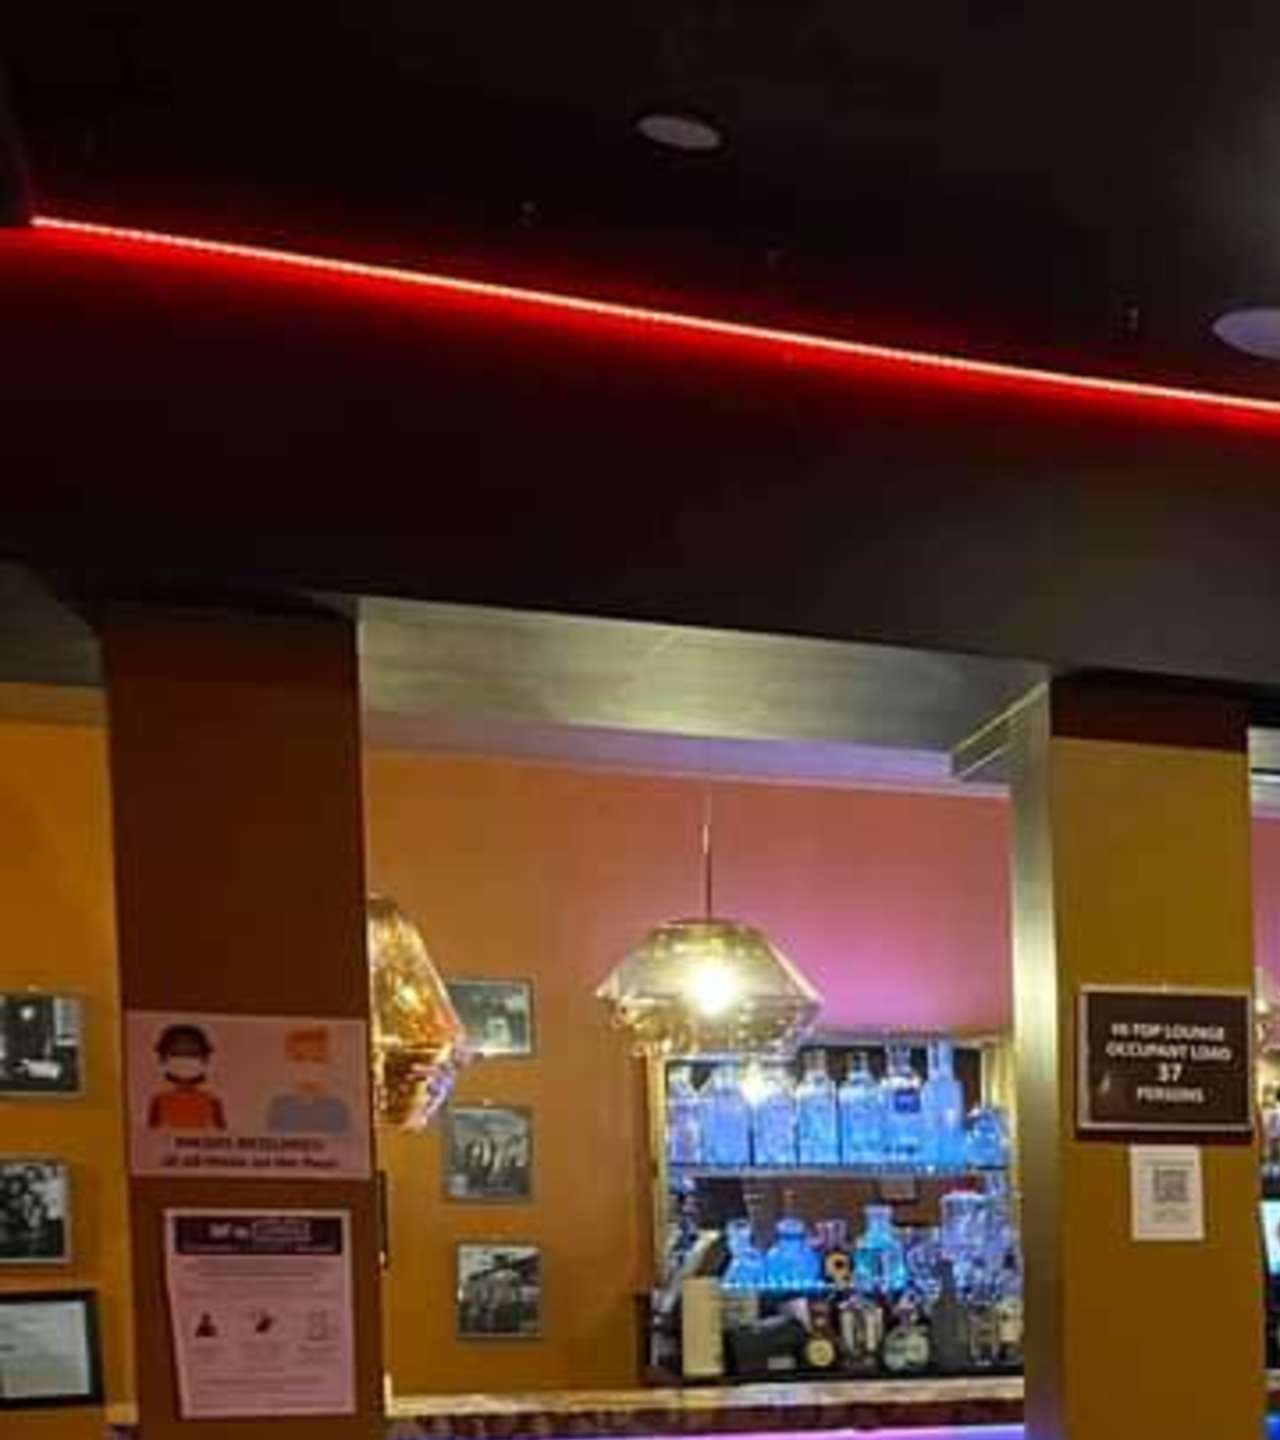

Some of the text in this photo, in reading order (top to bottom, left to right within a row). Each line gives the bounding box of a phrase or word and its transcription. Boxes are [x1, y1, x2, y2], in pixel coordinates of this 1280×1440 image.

[1164, 1024, 1225, 1042] LOUNGE
[1104, 1041, 1233, 1062] OCCUPANT LOAD
[1157, 1062, 1183, 1083] 37
[1136, 1086, 1205, 1103] PERSONS
